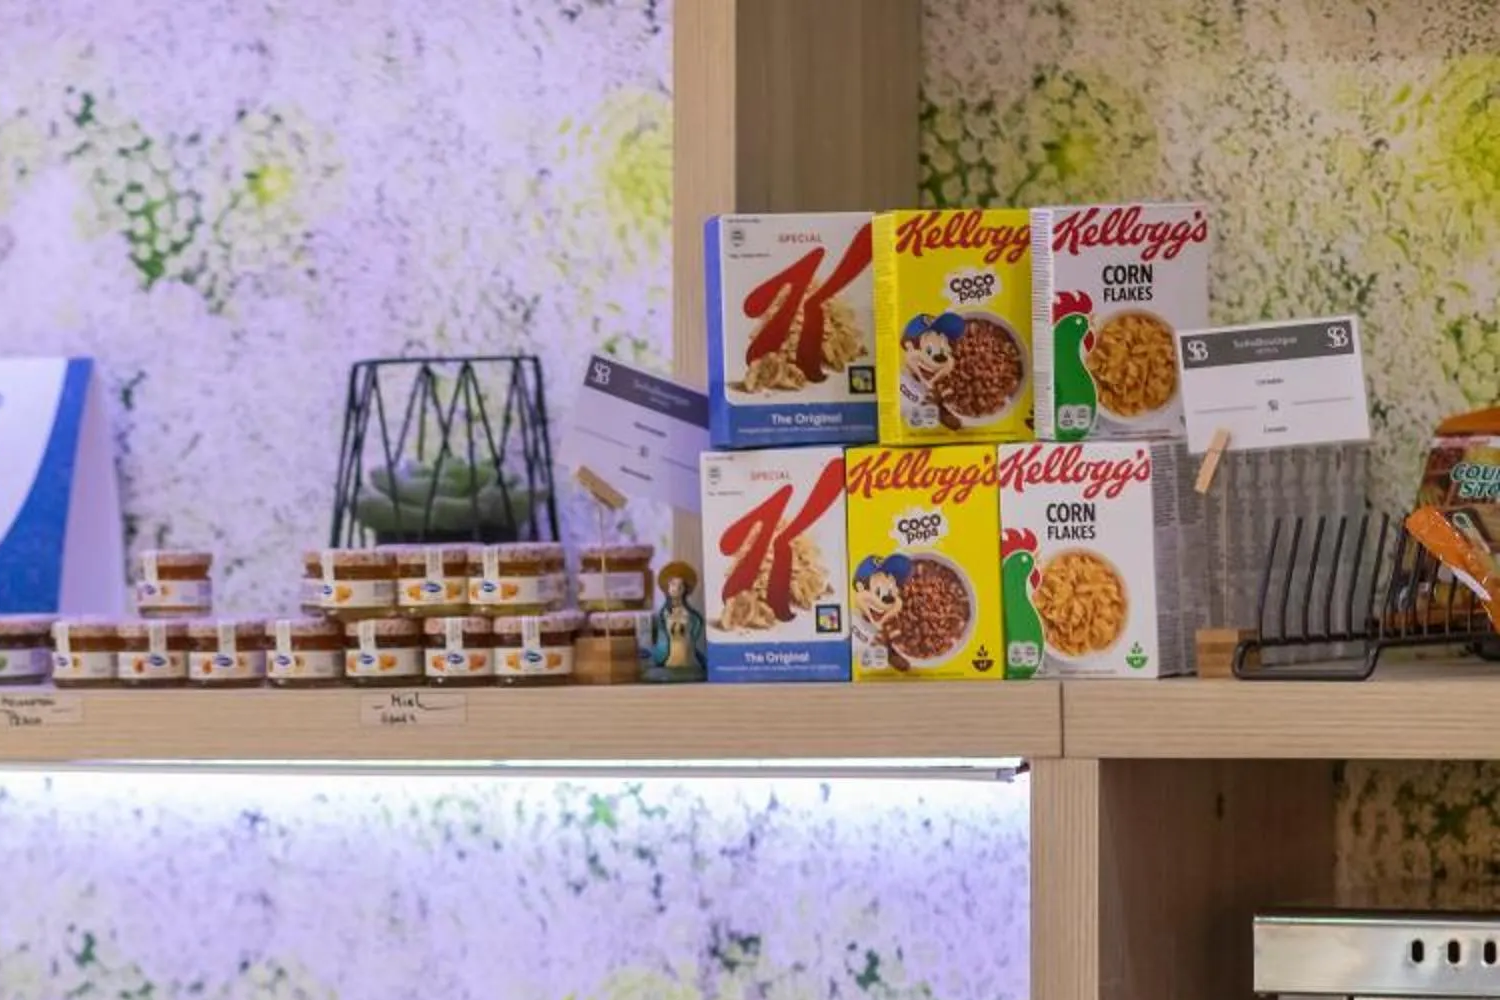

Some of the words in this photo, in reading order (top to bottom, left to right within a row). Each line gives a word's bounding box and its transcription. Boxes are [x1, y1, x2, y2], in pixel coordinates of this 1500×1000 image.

[778, 233, 823, 243] SPECIAL
[895, 208, 1031, 264] Kellogg
[1052, 206, 1207, 262] Kellogg's
[1102, 264, 1154, 285] CORN
[1103, 286, 1153, 302] FLAKES
[771, 413, 794, 425] The
[796, 412, 842, 427] Original
[848, 448, 998, 504] Kellogg's
[1000, 443, 1150, 500] Kellogg's
[1046, 503, 1096, 523] CORN
[1047, 525, 1096, 540] FLAKES
[744, 652, 765, 663] The
[766, 652, 810, 665] Original
